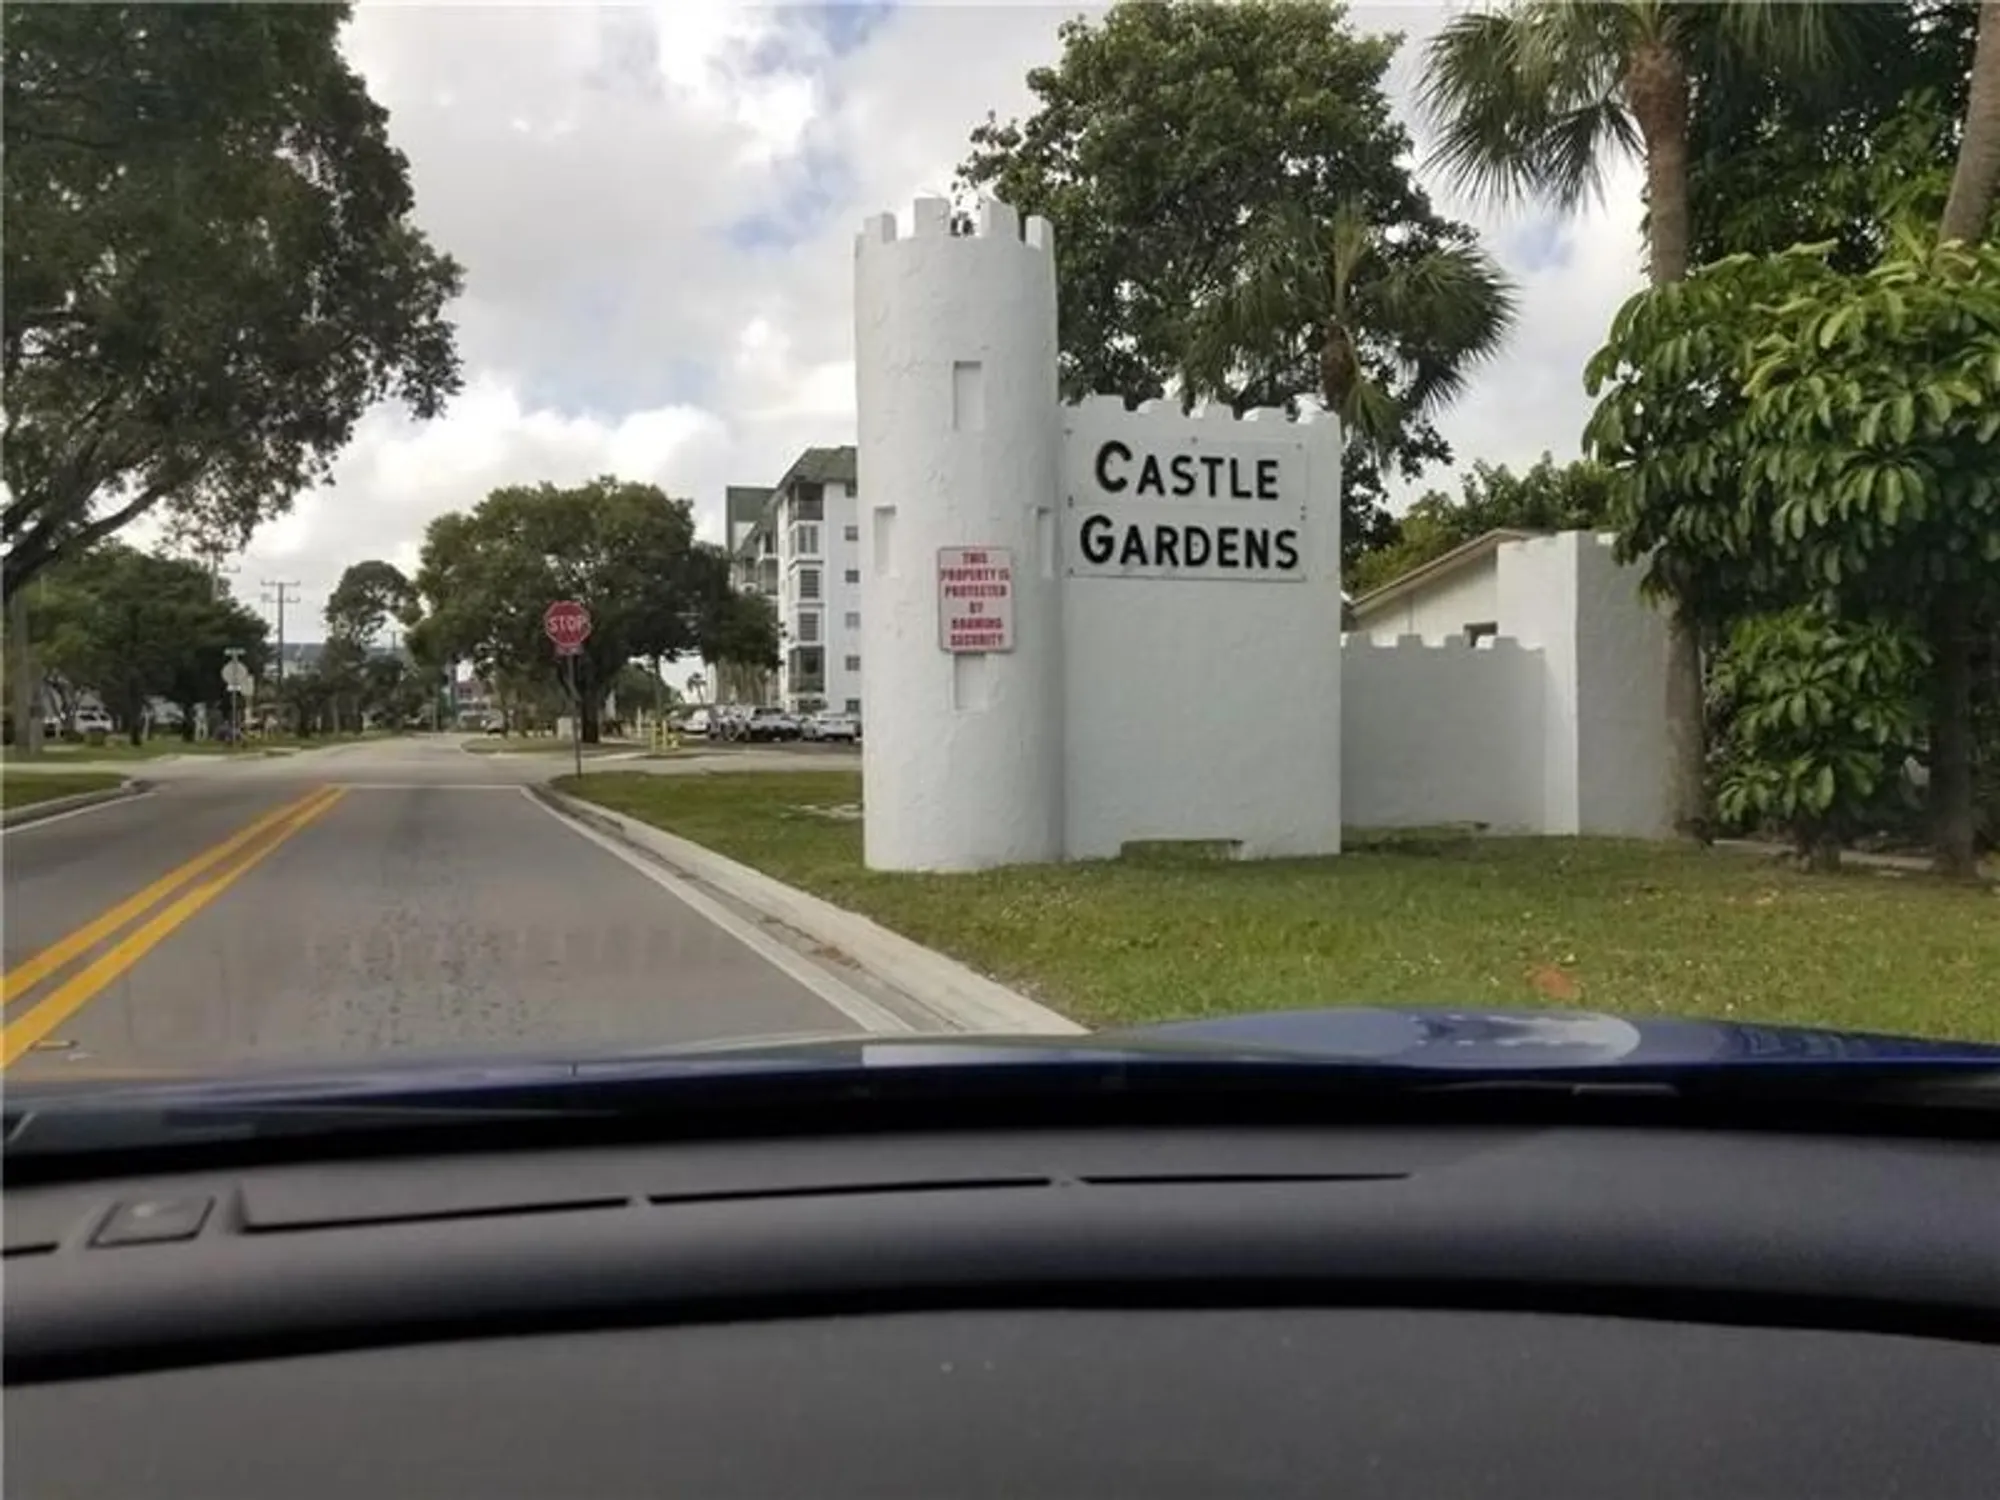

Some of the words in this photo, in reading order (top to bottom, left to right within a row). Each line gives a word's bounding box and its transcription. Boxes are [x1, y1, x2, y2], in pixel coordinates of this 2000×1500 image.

[1095, 440, 1279, 500] CASTLE
[1080, 514, 1299, 570] GARDENS
[940, 568, 997, 581] PROPERTY
[944, 584, 1007, 597] PROTECTED
[548, 614, 589, 634] STOP
